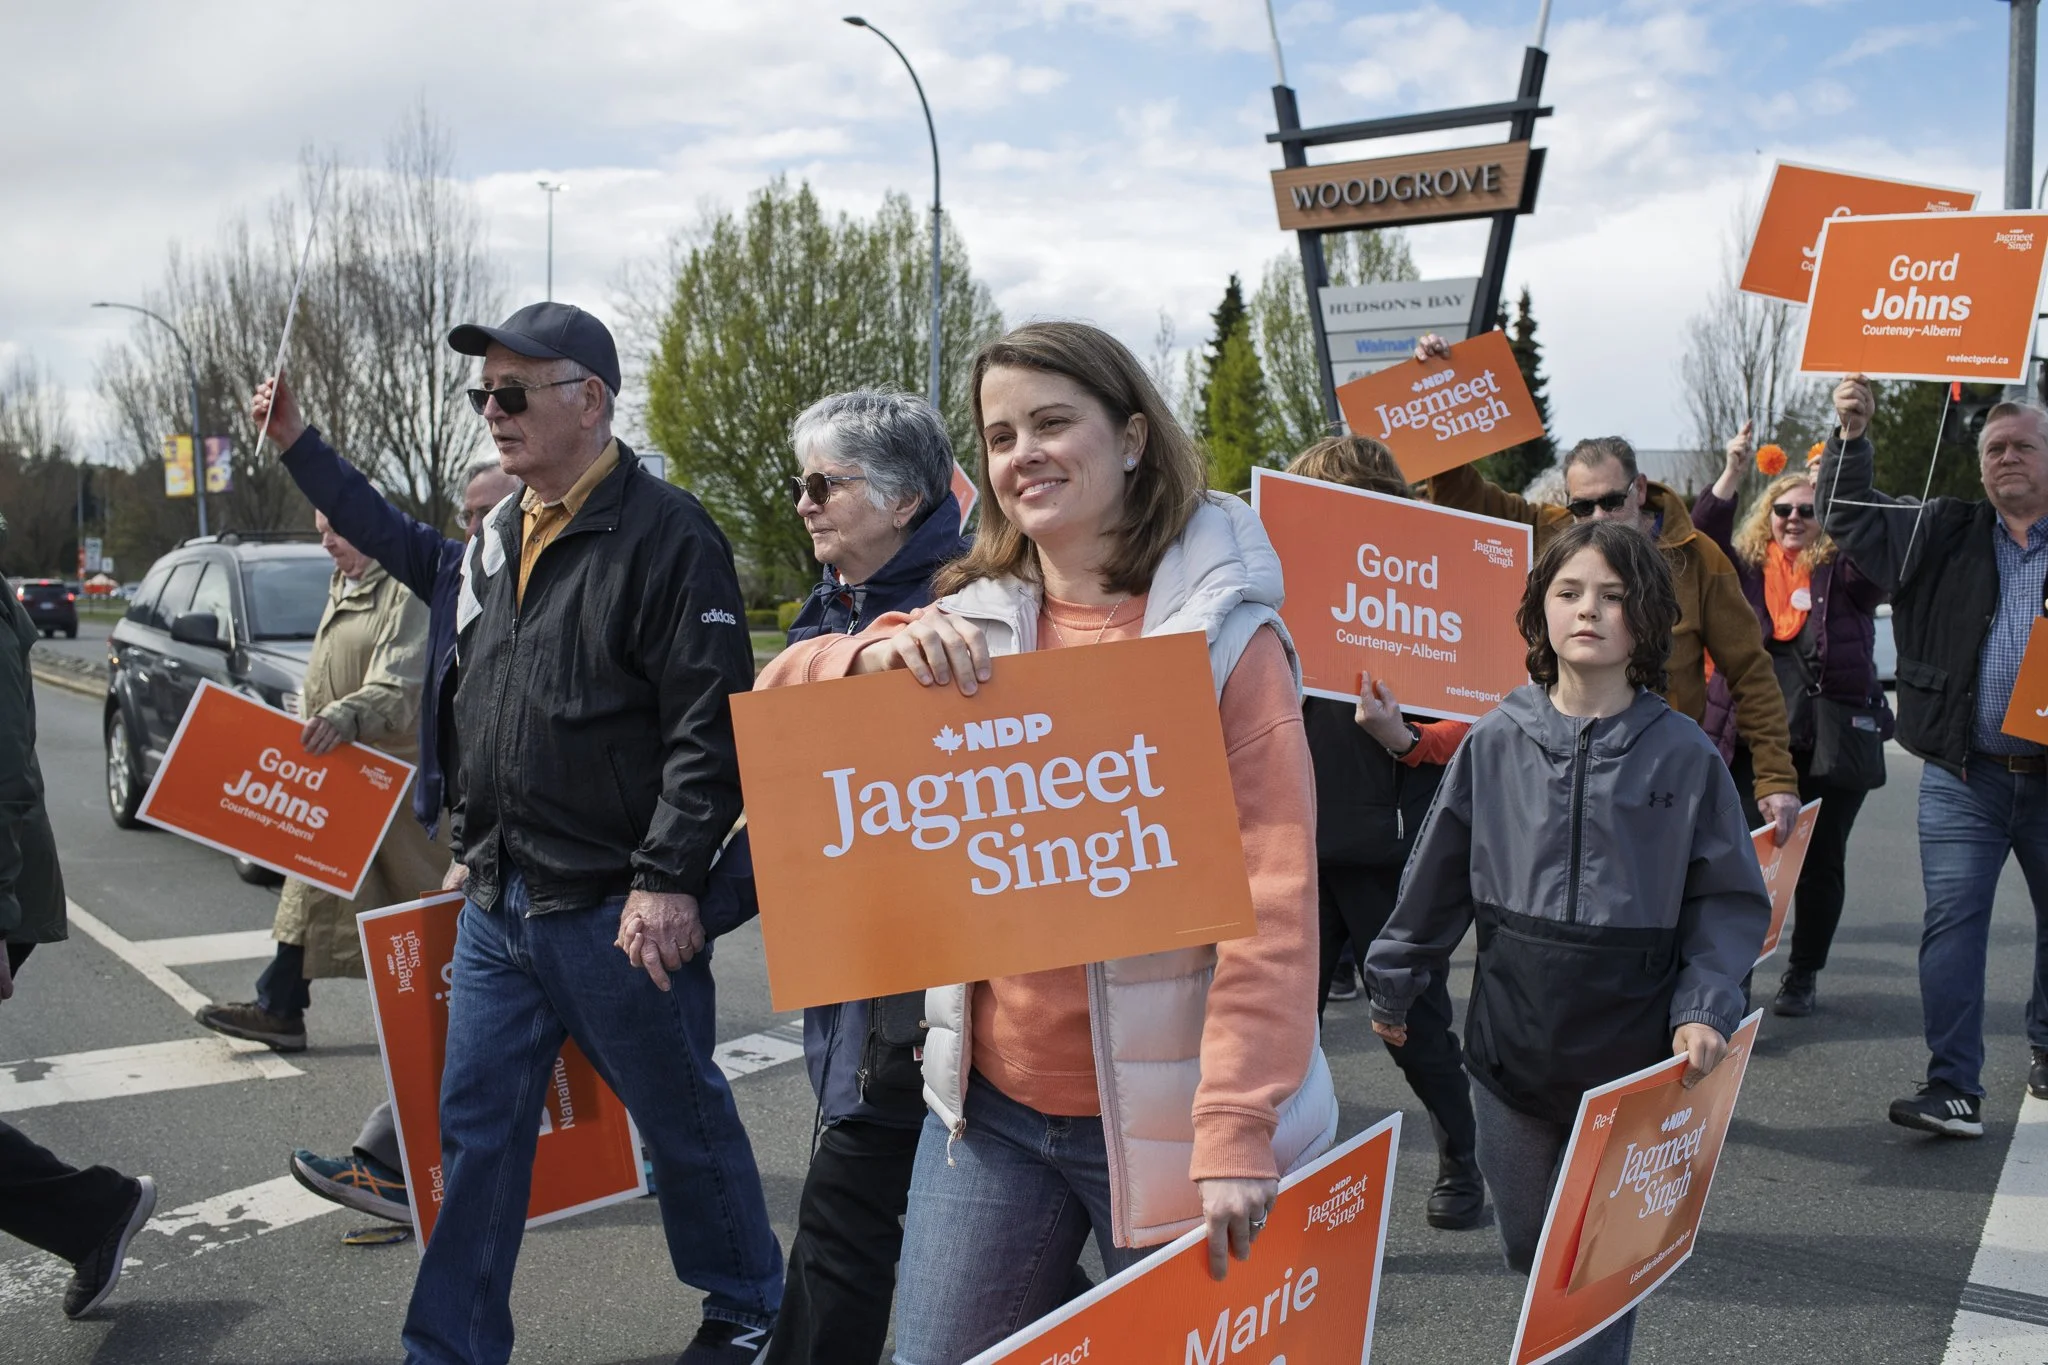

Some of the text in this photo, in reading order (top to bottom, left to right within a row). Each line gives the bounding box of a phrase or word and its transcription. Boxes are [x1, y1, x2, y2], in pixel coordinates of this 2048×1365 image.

[1291, 163, 1502, 210] WOODGROVE
[1889, 253, 1960, 281] Gord
[1428, 294, 1465, 309] BAY
[1862, 286, 1972, 321] Johns
[1355, 336, 1416, 353] Walmart
[1946, 354, 2009, 366] reelectgord.ca
[1423, 369, 1456, 390] NDP
[1374, 369, 1501, 440] Jagmeet
[1432, 396, 1511, 441] Singh
[1357, 543, 1438, 590] Gord
[1472, 539, 1513, 557] Jagmeet
[1488, 553, 1513, 568] Singh
[701, 608, 736, 625] adidas
[1331, 582, 1462, 643] Johns
[1446, 686, 1501, 702] reelectgord
[963, 712, 1053, 752] NDP
[258, 747, 328, 792] Gord
[223, 770, 330, 830] Johns
[822, 733, 1165, 858] Jagmeet
[966, 805, 1178, 898] Singh
[1760, 854, 1782, 884] ord
[389, 933, 415, 995] Jagmeet
[403, 929, 421, 968] Singh
[1668, 1107, 1693, 1132] NDP
[1609, 1118, 1708, 1199] Jagmeet
[1335, 1175, 1352, 1191] NDP
[1638, 1162, 1693, 1219] Singh
[1303, 1174, 1369, 1232] Jagmeet
[1327, 1195, 1365, 1231] Singh
[1185, 1266, 1319, 1365] Marie
